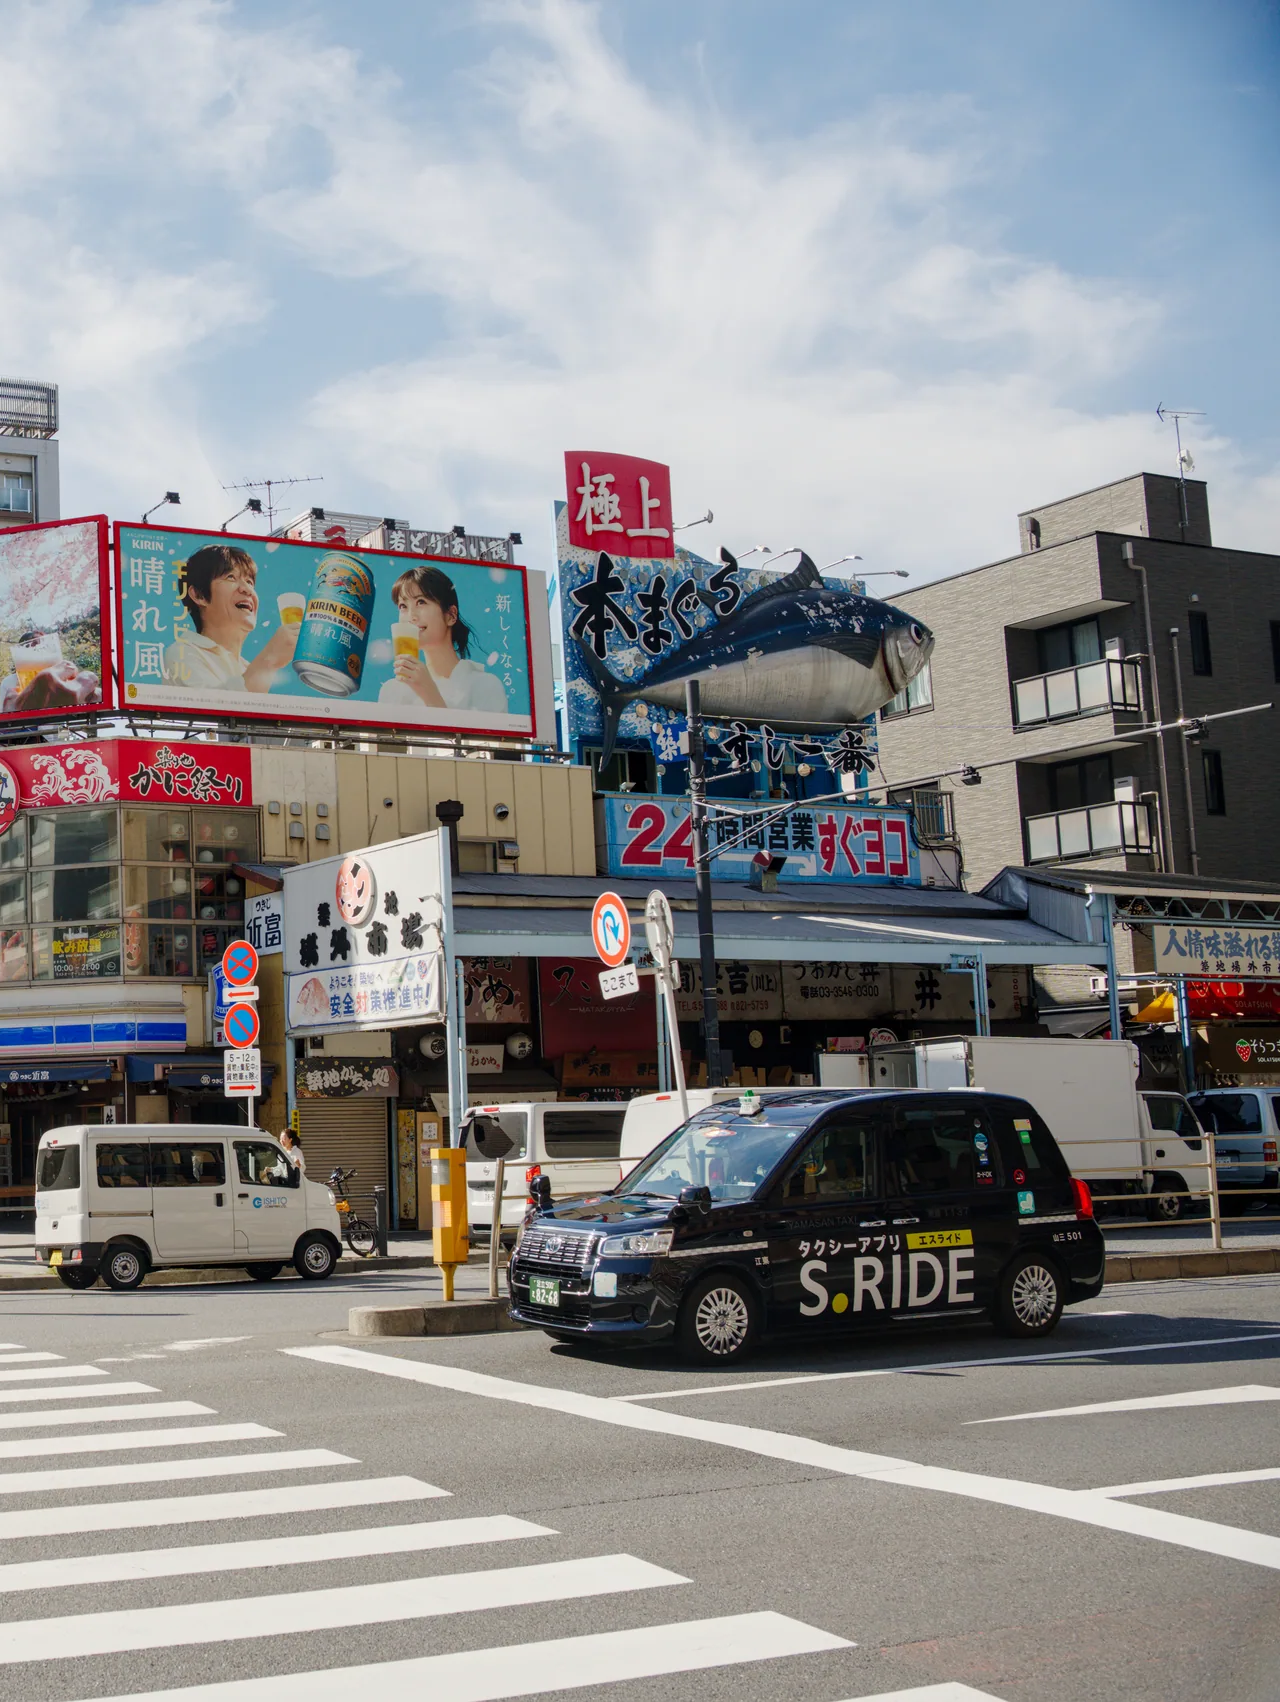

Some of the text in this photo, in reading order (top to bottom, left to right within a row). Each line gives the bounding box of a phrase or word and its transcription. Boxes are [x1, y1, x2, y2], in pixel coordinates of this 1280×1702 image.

[575, 462, 670, 538] 極上
[132, 539, 165, 552] KIRIN
[310, 601, 363, 627] KIRIN BEER
[570, 546, 741, 660] 本まぐろ
[130, 556, 170, 681] 晴れ風
[172, 560, 192, 681] キリンビール
[310, 623, 352, 648] 晴れ風
[495, 594, 515, 694] 新しくなる。
[155, 746, 195, 769] 築地
[721, 721, 876, 775] すし一番
[129, 764, 243, 803] かに祭り
[817, 813, 910, 877] すぐヨコ
[255, 898, 272, 912] つきじ
[246, 912, 281, 950] 近富
[52, 938, 101, 954] 飲み放題
[1200, 960, 1280, 974] 築地場外市
[603, 972, 634, 993] ここまで
[471, 1054, 497, 1067] おかめ
[306, 1065, 389, 1091] 築地がちゃ処
[787, 1215, 857, 1231] YAMASAN TAXI
[1066, 1231, 1082, 1241] 501
[798, 1233, 961, 1258] タクシーアプリ エスライド
[798, 1248, 975, 1317] S.RIDE
